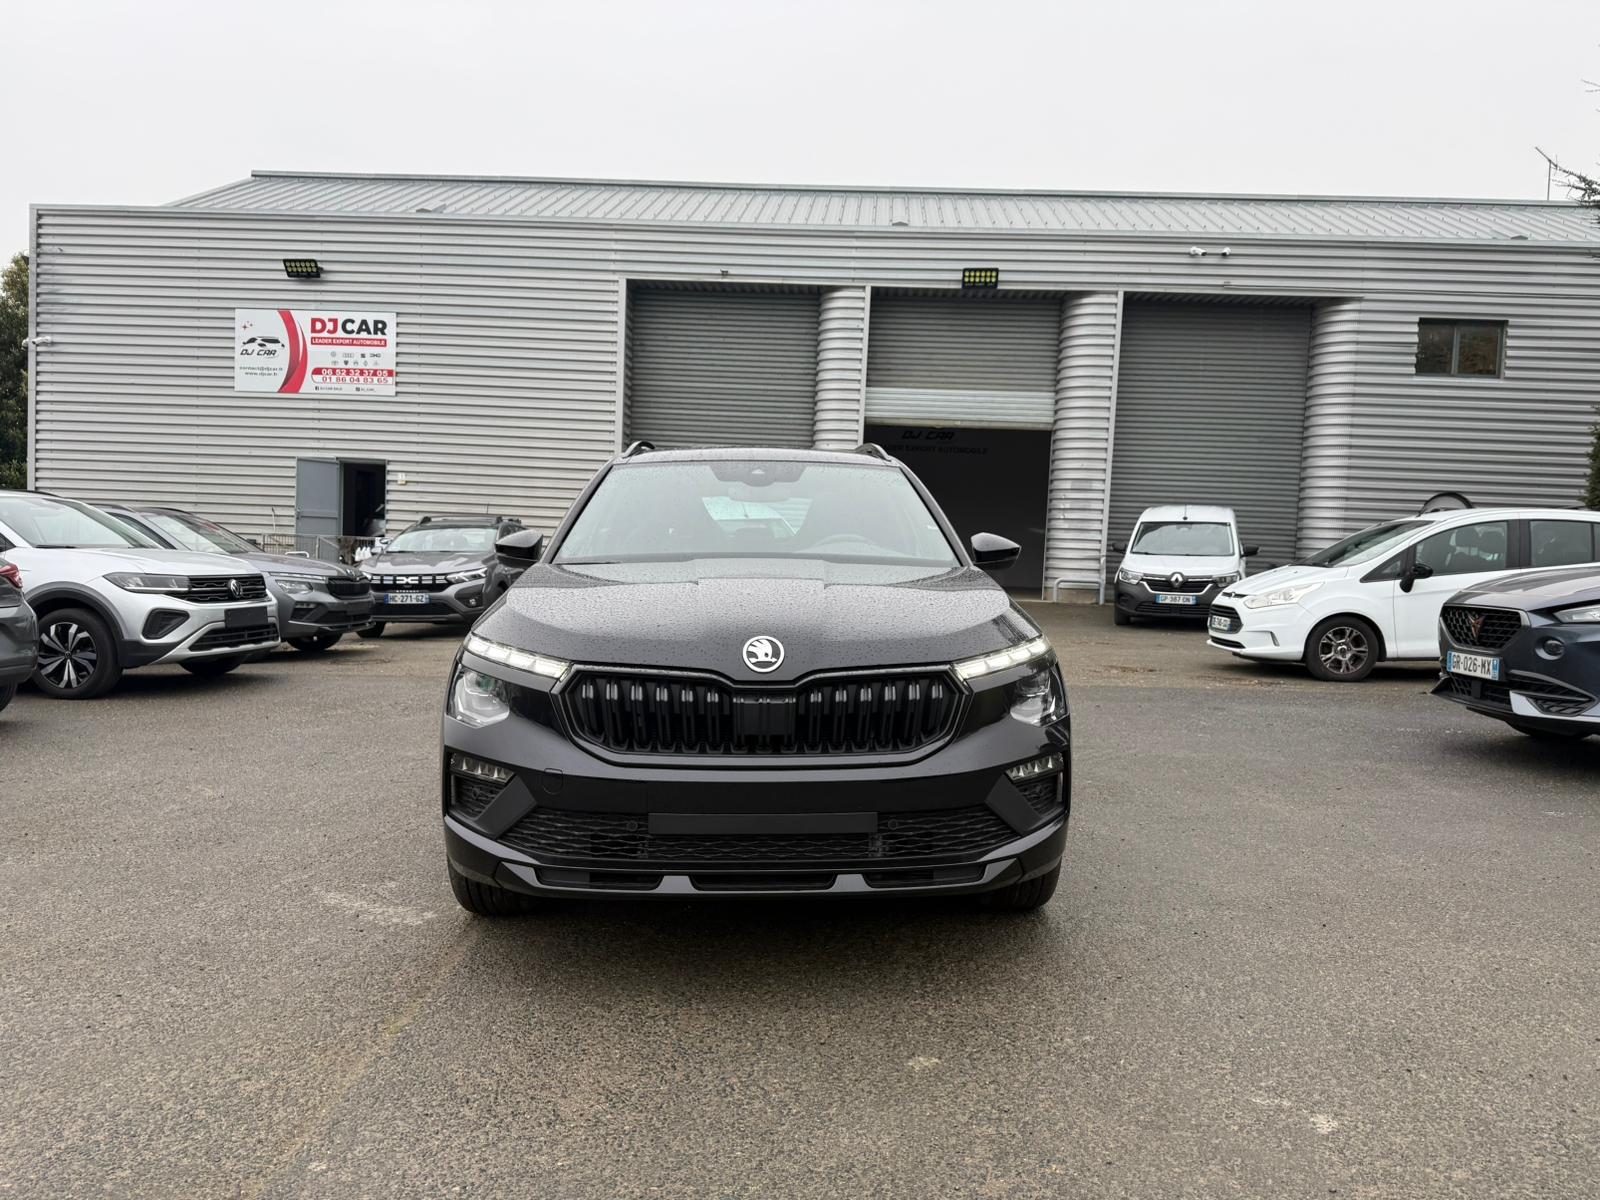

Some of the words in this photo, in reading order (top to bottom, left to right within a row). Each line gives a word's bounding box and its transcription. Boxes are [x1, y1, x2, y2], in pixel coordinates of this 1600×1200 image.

[311, 317, 338, 334] DJ
[341, 319, 387, 335] CAR
[322, 368, 333, 376] 06
[363, 369, 374, 377] 37
[902, 430, 922, 440] DJ
[925, 430, 955, 441] CAR
